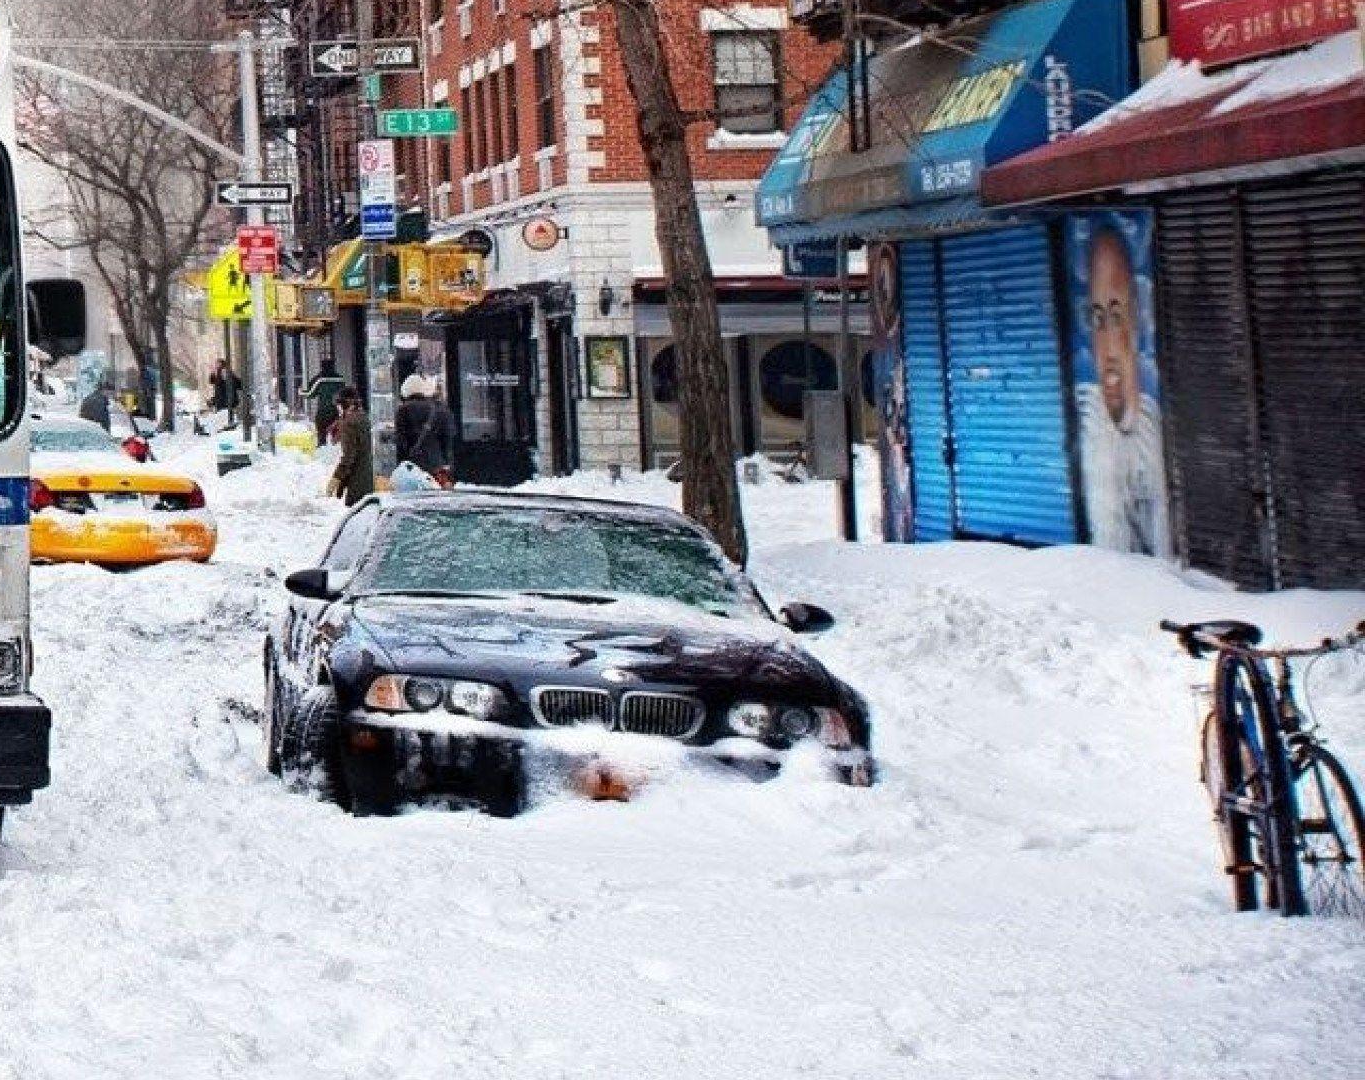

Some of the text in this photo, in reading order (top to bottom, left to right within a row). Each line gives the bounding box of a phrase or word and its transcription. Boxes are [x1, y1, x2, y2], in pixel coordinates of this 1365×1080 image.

[387, 114, 398, 131] E
[407, 114, 430, 131] 13
[260, 189, 283, 197] WAY
